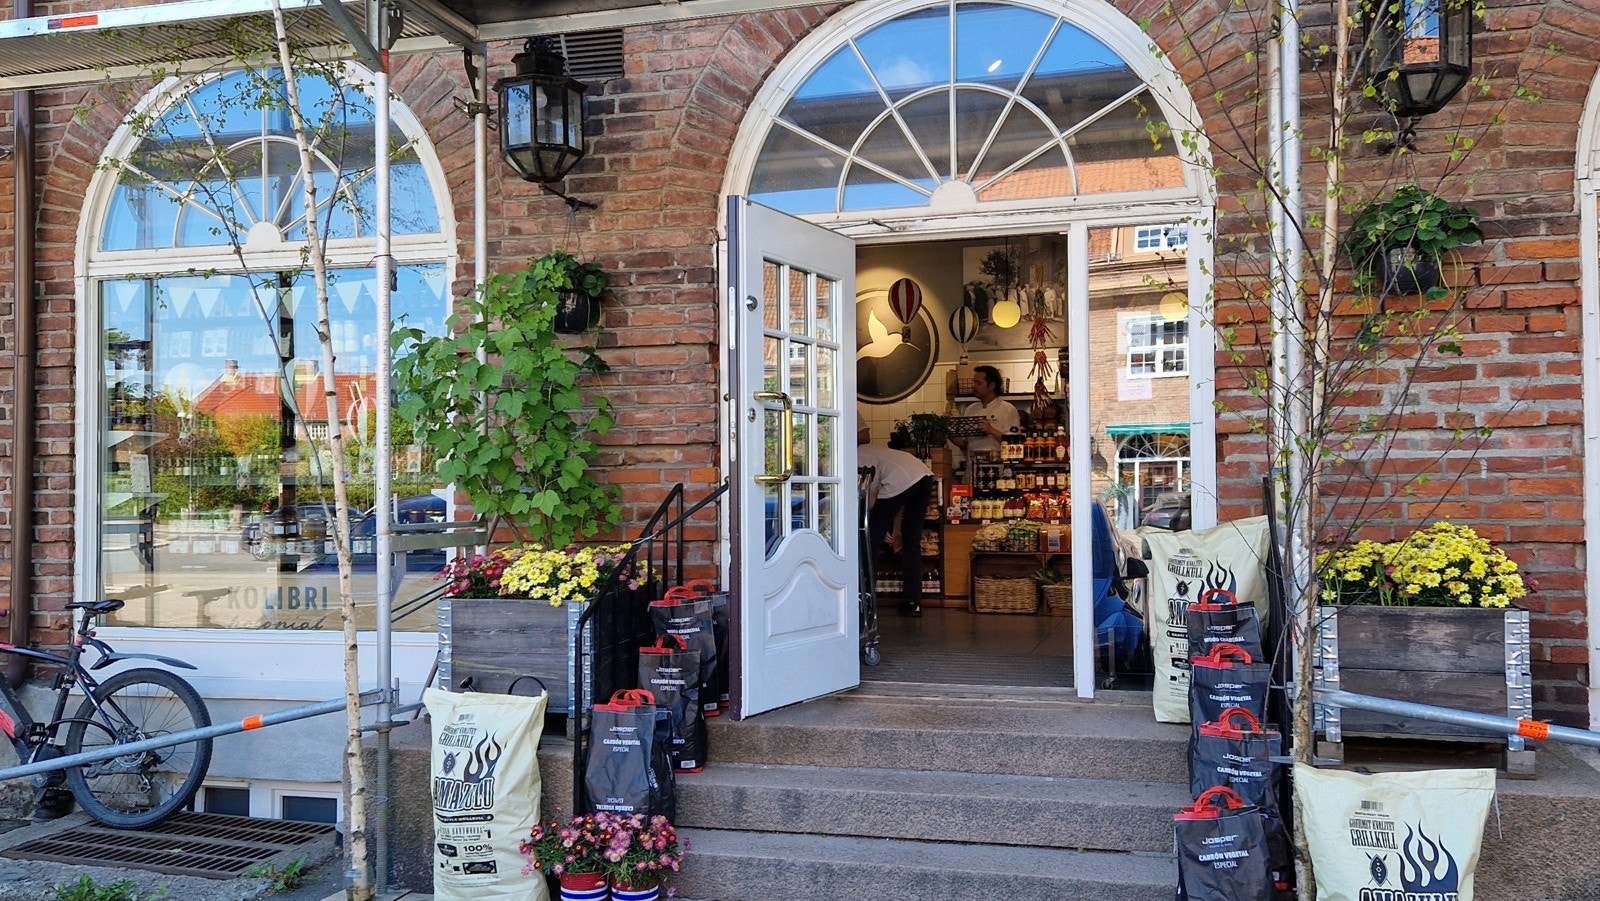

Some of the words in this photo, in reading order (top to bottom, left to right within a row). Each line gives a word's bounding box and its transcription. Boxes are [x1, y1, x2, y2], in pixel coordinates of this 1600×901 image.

[1167, 562, 1203, 578] GRILLKULL
[227, 586, 328, 610] KOLIBRI
[1222, 753, 1255, 763] Josper
[1201, 834, 1239, 845] Josper
[1350, 829, 1399, 849] GRILLKULL
[463, 843, 493, 852] 100%
[1198, 852, 1224, 862] CARBÓN
